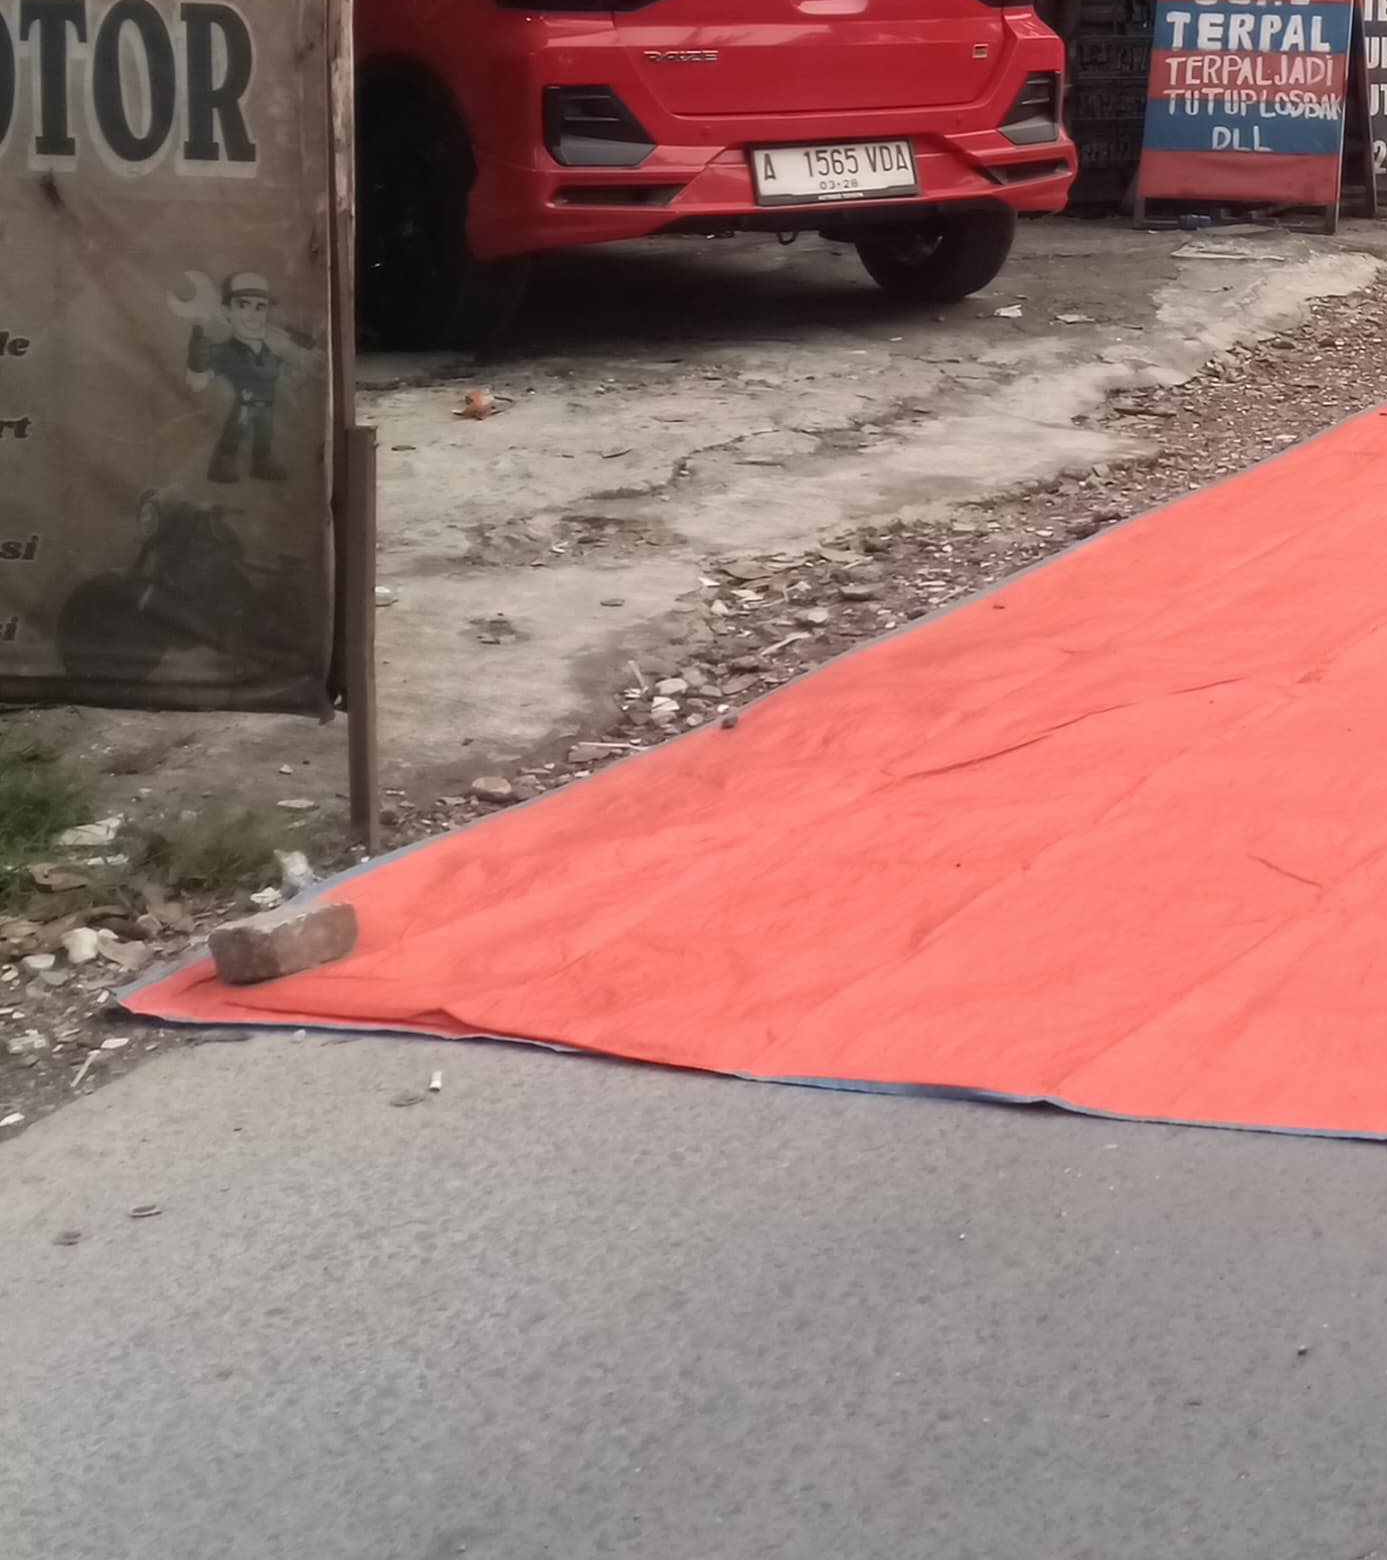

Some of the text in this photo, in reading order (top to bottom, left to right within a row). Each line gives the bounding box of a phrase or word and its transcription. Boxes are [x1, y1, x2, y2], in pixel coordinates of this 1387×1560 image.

[1166, 11, 1331, 52] TERPAL
[1162, 87, 1257, 118] TUTUP
[1211, 124, 1273, 151] DLL
[763, 144, 909, 181] A 1565 VDA
